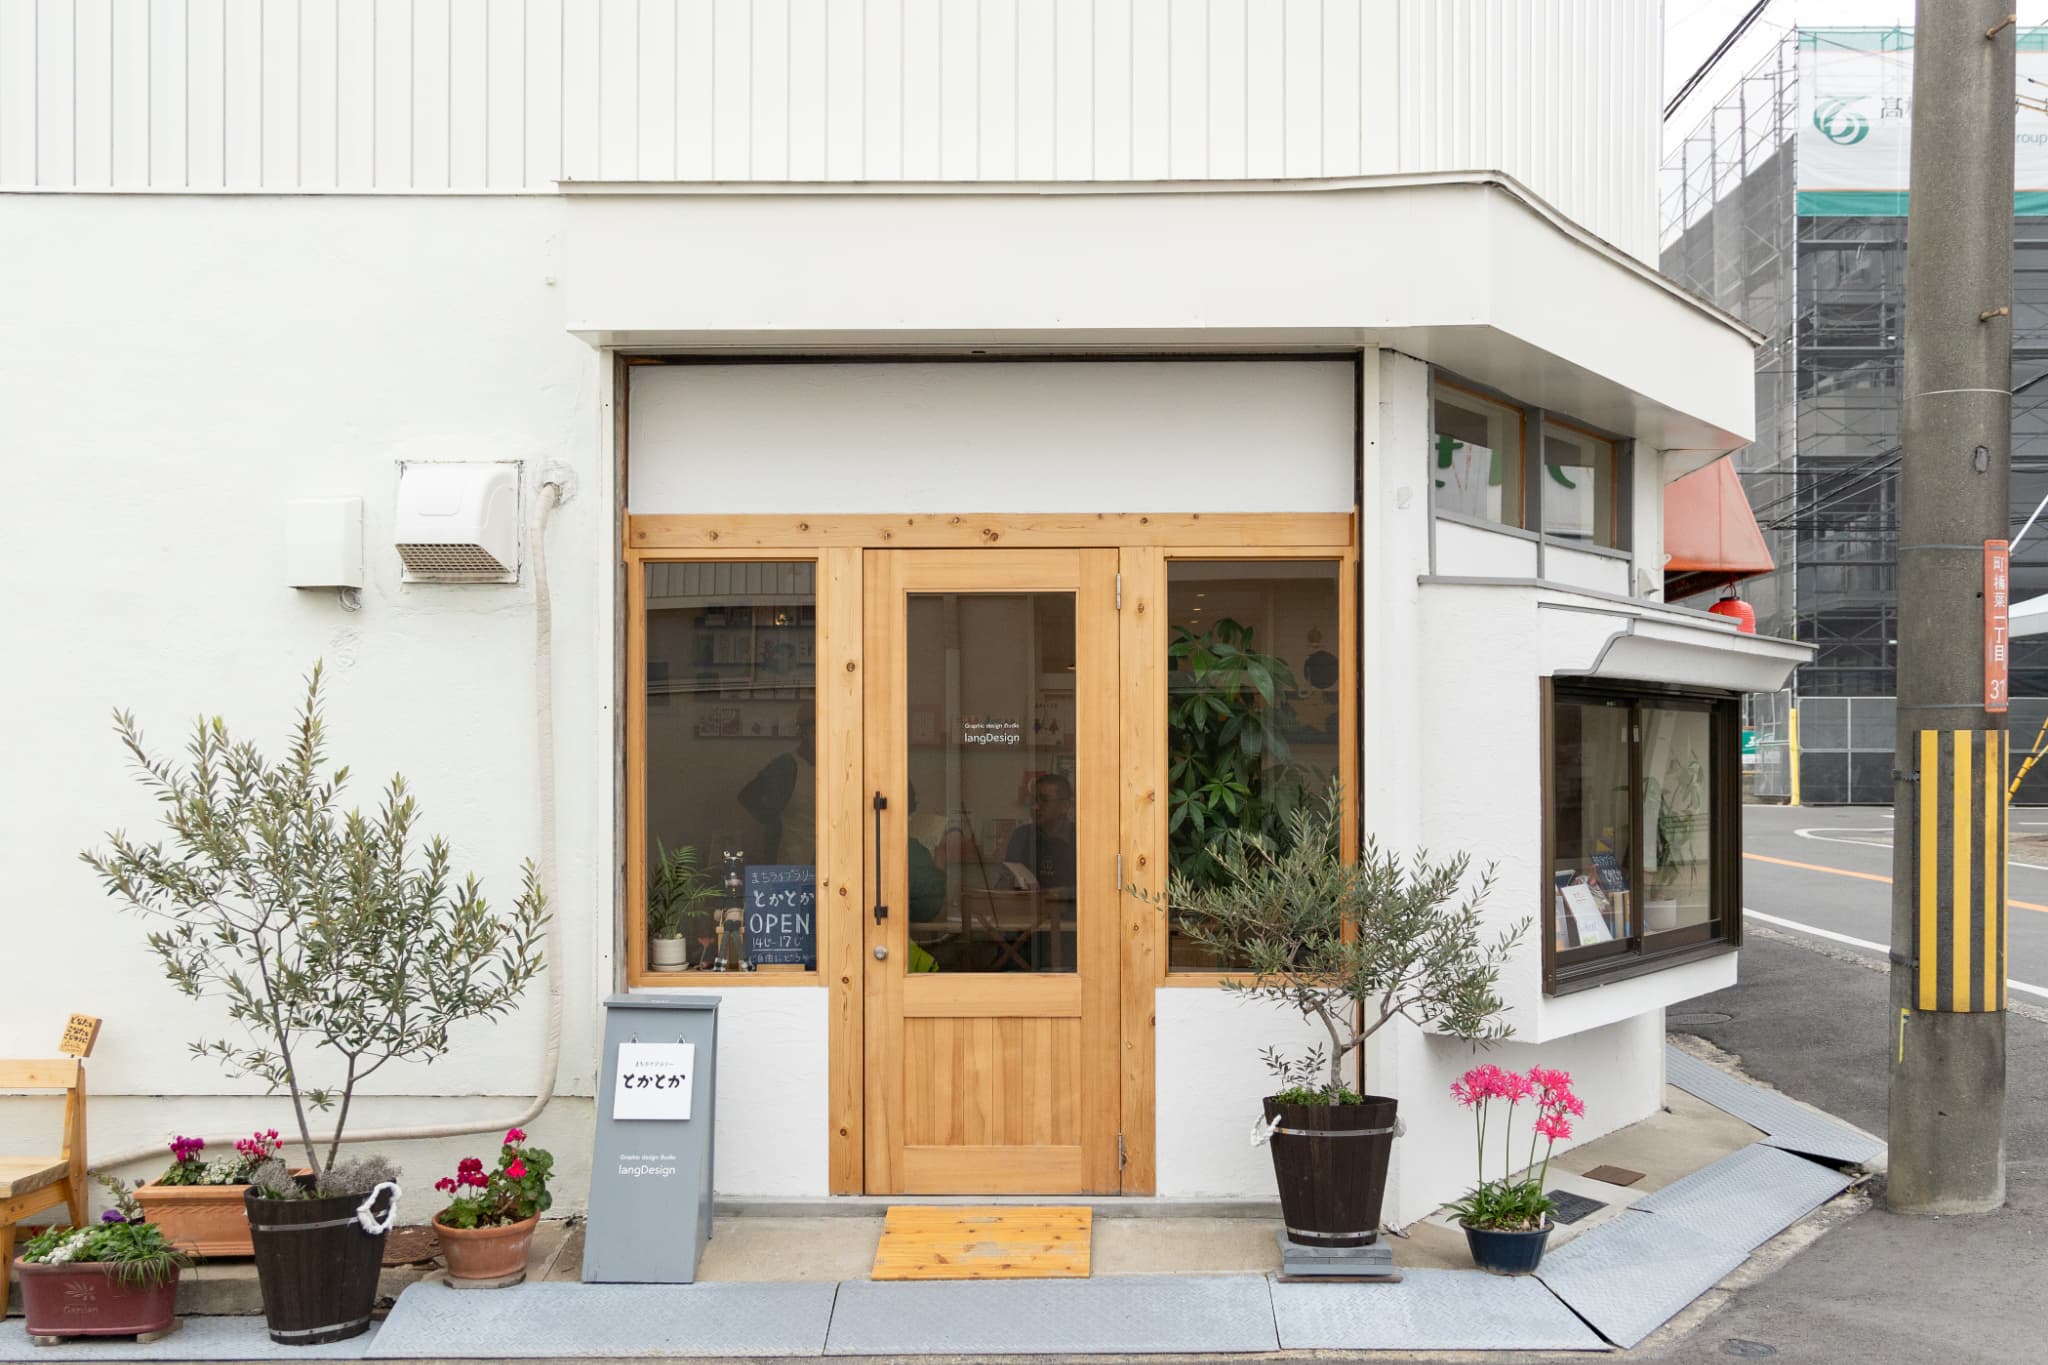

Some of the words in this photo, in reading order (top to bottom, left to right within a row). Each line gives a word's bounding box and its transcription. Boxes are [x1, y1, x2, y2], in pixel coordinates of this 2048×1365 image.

[2016, 132, 2048, 144] roup
[964, 732, 1020, 744] langDesign
[753, 889, 815, 907] とかとか
[749, 913, 810, 935] OPEN
[623, 1073, 686, 1089] とかとか
[618, 1164, 676, 1177] langDesign
